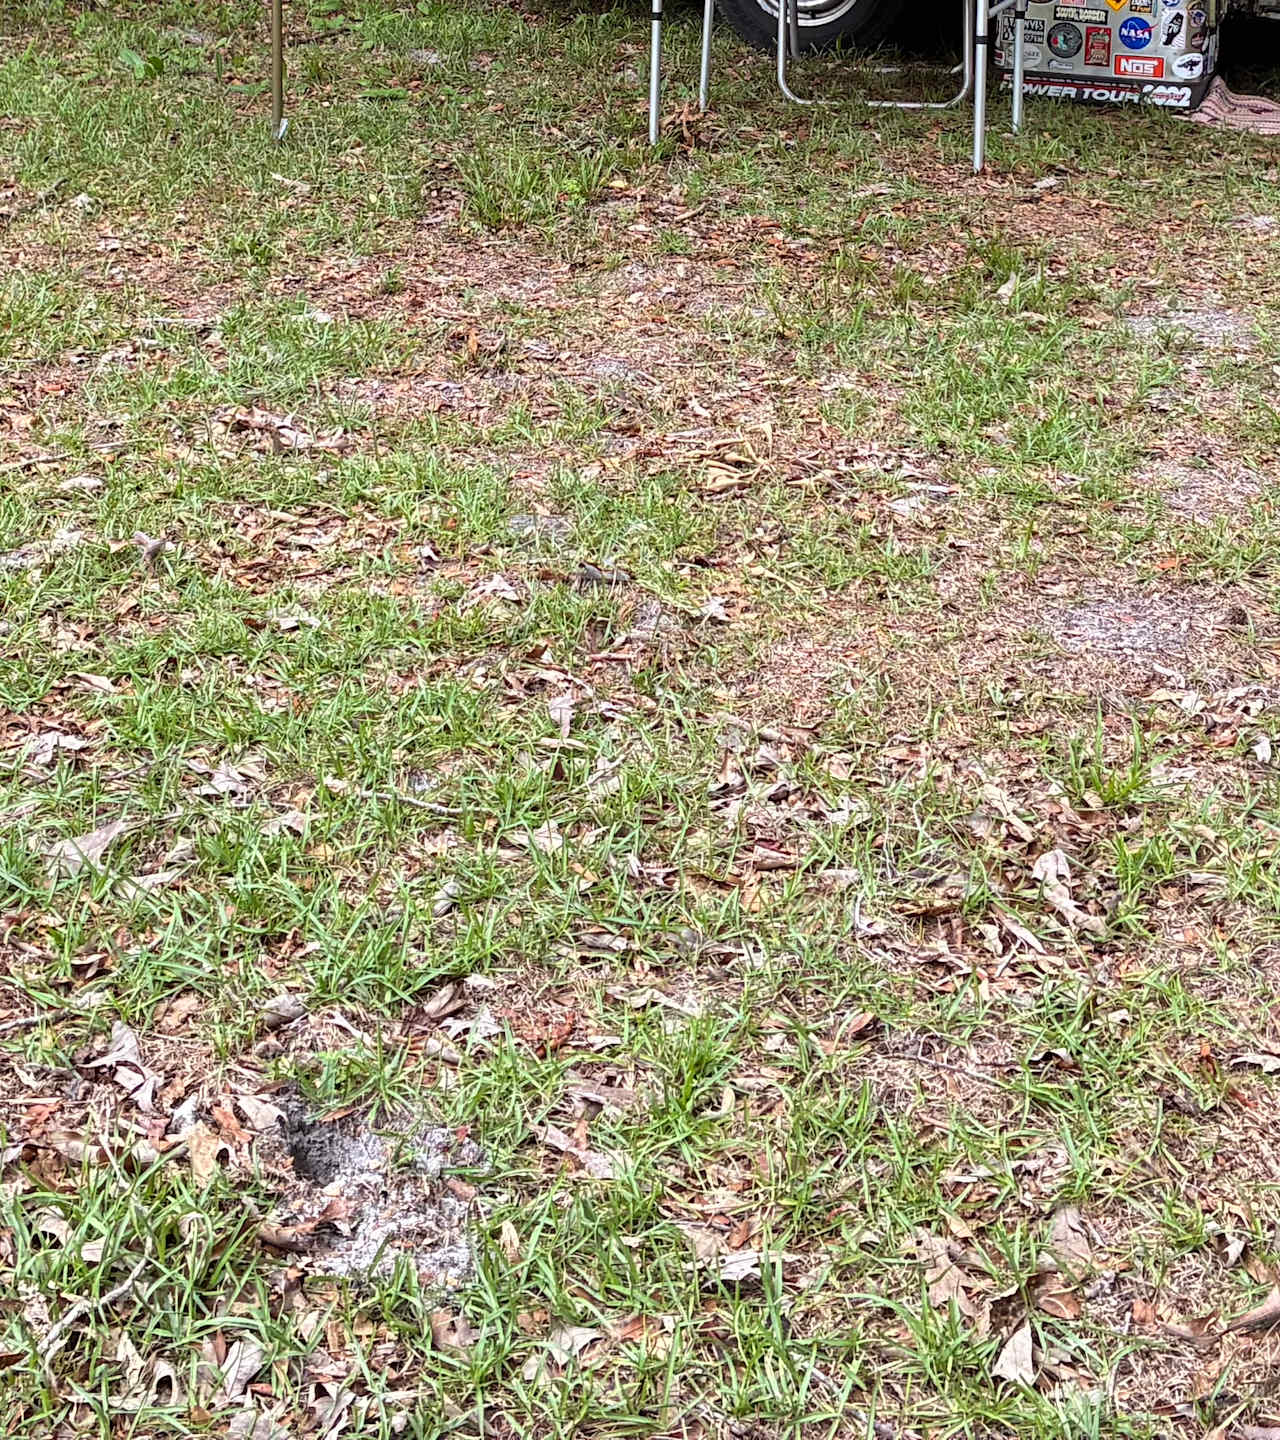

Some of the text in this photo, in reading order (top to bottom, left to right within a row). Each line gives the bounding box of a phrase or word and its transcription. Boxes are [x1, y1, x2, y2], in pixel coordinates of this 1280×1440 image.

[1120, 27, 1150, 40] NASA
[1121, 58, 1159, 74] NOS
[1082, 87, 1140, 104] TOUR
